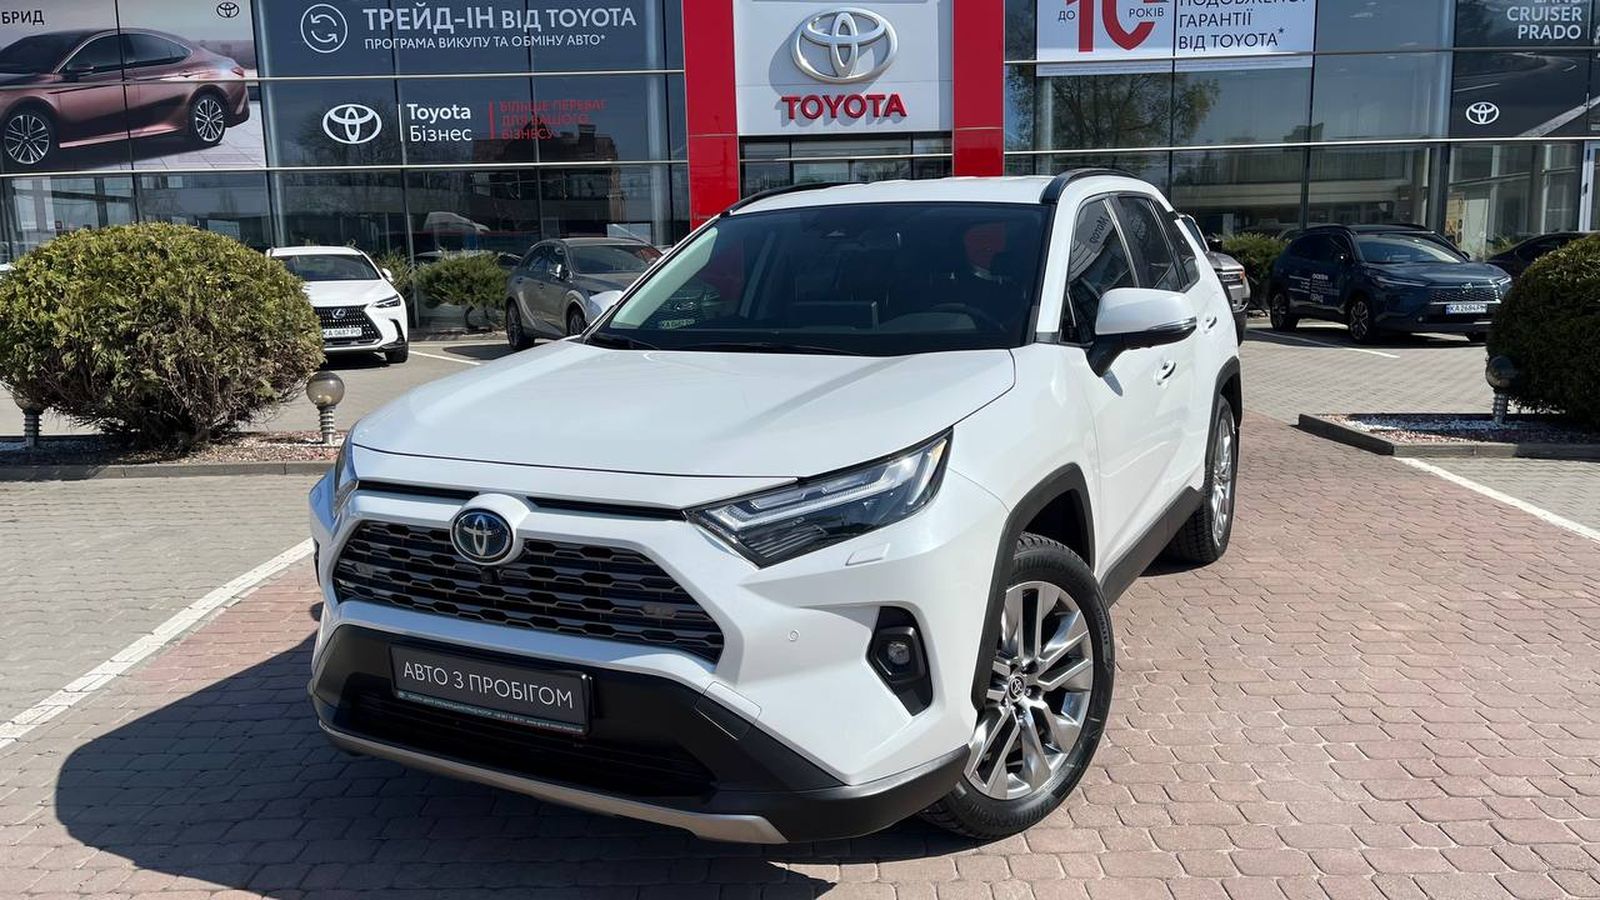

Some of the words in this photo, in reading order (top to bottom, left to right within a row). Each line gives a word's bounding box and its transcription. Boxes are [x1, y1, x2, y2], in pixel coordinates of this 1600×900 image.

[363, 2, 494, 34] ТРЕЙД-ІН
[502, 9, 541, 32] ВІД
[546, 8, 637, 27] TOYOTA
[1058, 10, 1076, 22] ДО
[1129, 7, 1165, 18] РОКІВ
[1179, 8, 1253, 28] ГАРАНТІЇ
[1506, 6, 1582, 21] CRUISER
[1518, 24, 1581, 39] PRADO
[365, 38, 435, 49] ПРОГРАМА
[439, 37, 490, 48] ВИКУПУ
[493, 36, 509, 47] ТА
[511, 35, 563, 47] ОБМІНУ
[1179, 35, 1206, 52] ВІД
[407, 103, 471, 124] Toyota
[781, 93, 908, 120] TOYOTA
[410, 125, 473, 142] Бізнес
[404, 662, 448, 686] АВТО
[468, 673, 574, 709] ПРОБІГОМ
